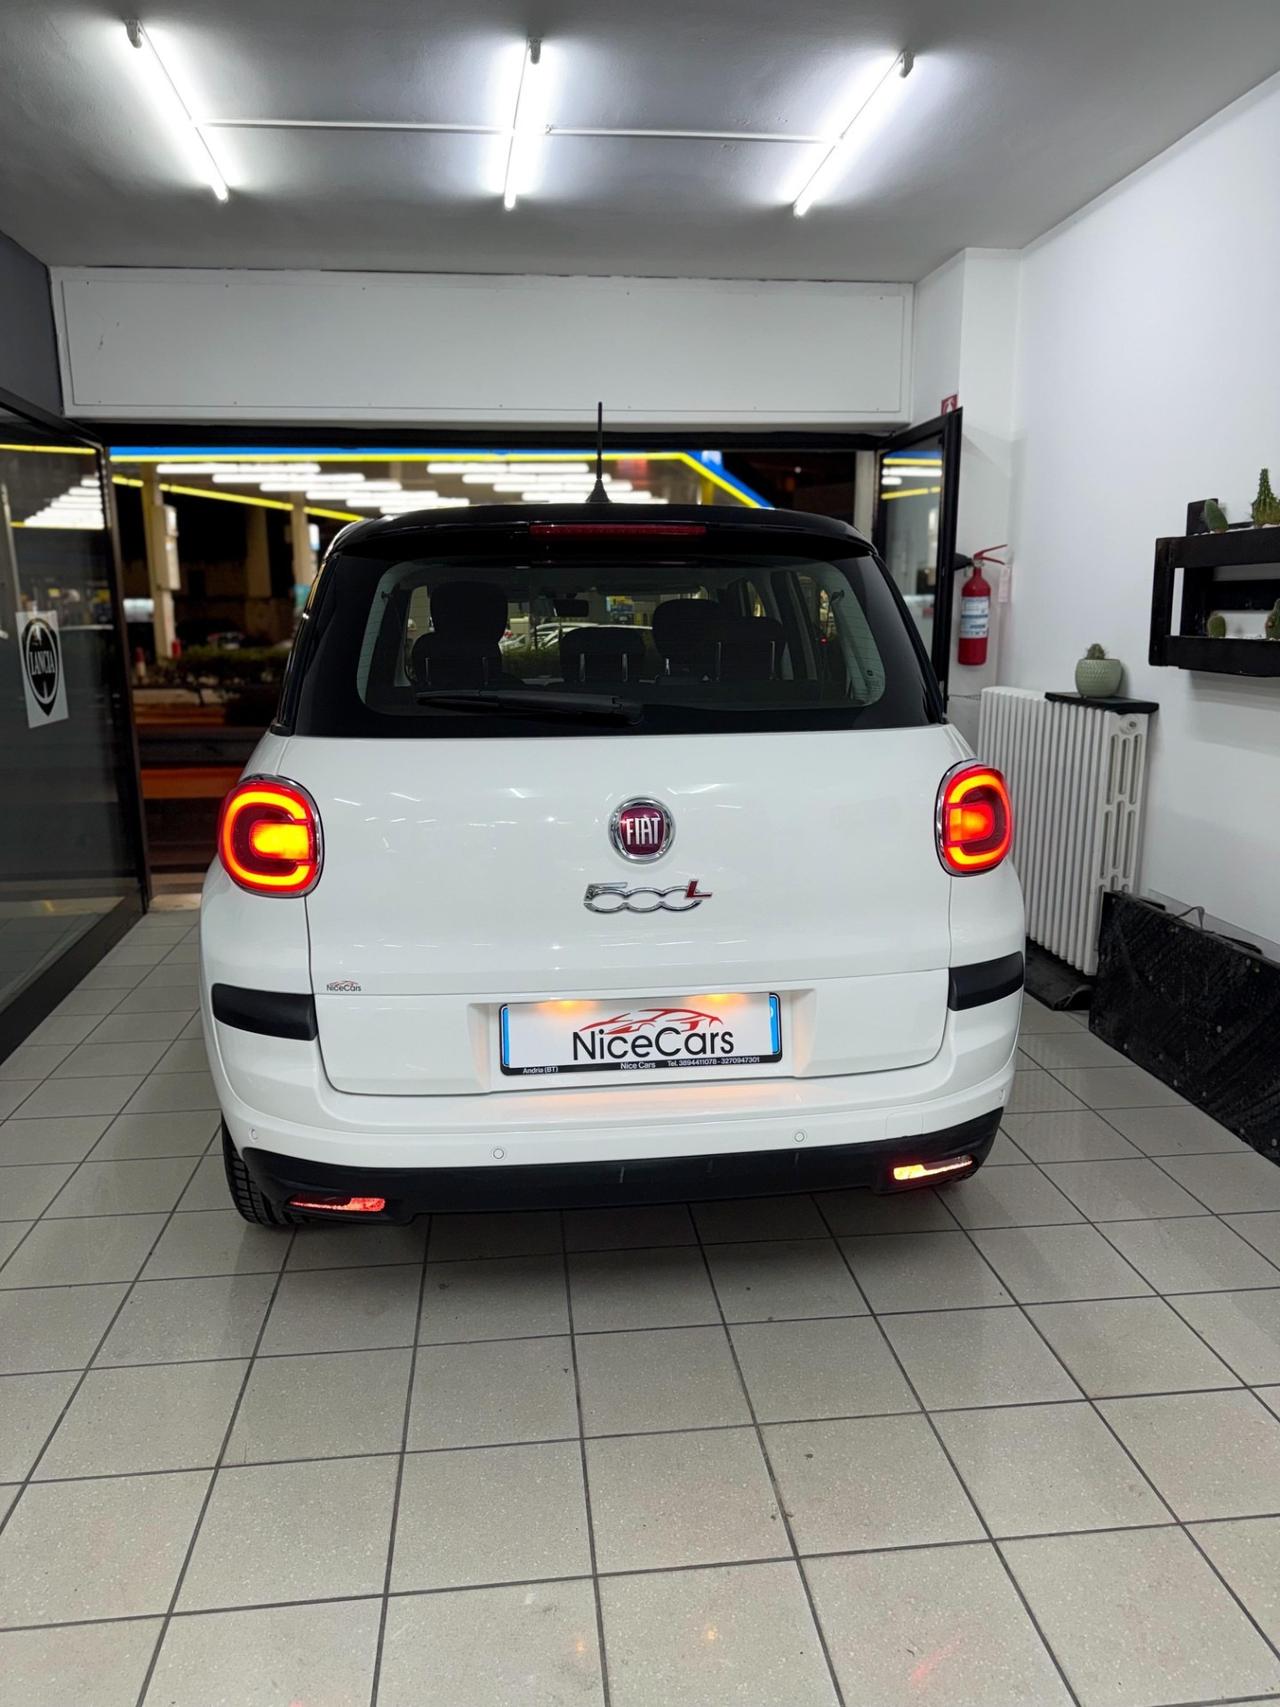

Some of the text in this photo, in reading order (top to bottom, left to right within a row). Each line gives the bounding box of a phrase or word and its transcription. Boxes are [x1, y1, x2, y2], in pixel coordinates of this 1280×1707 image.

[29, 650, 56, 676] LANCIA
[625, 816, 661, 845] FIAT
[583, 879, 714, 914] 500L
[572, 1026, 735, 1061] NiceCars
[620, 1061, 656, 1070] Nice Cars
